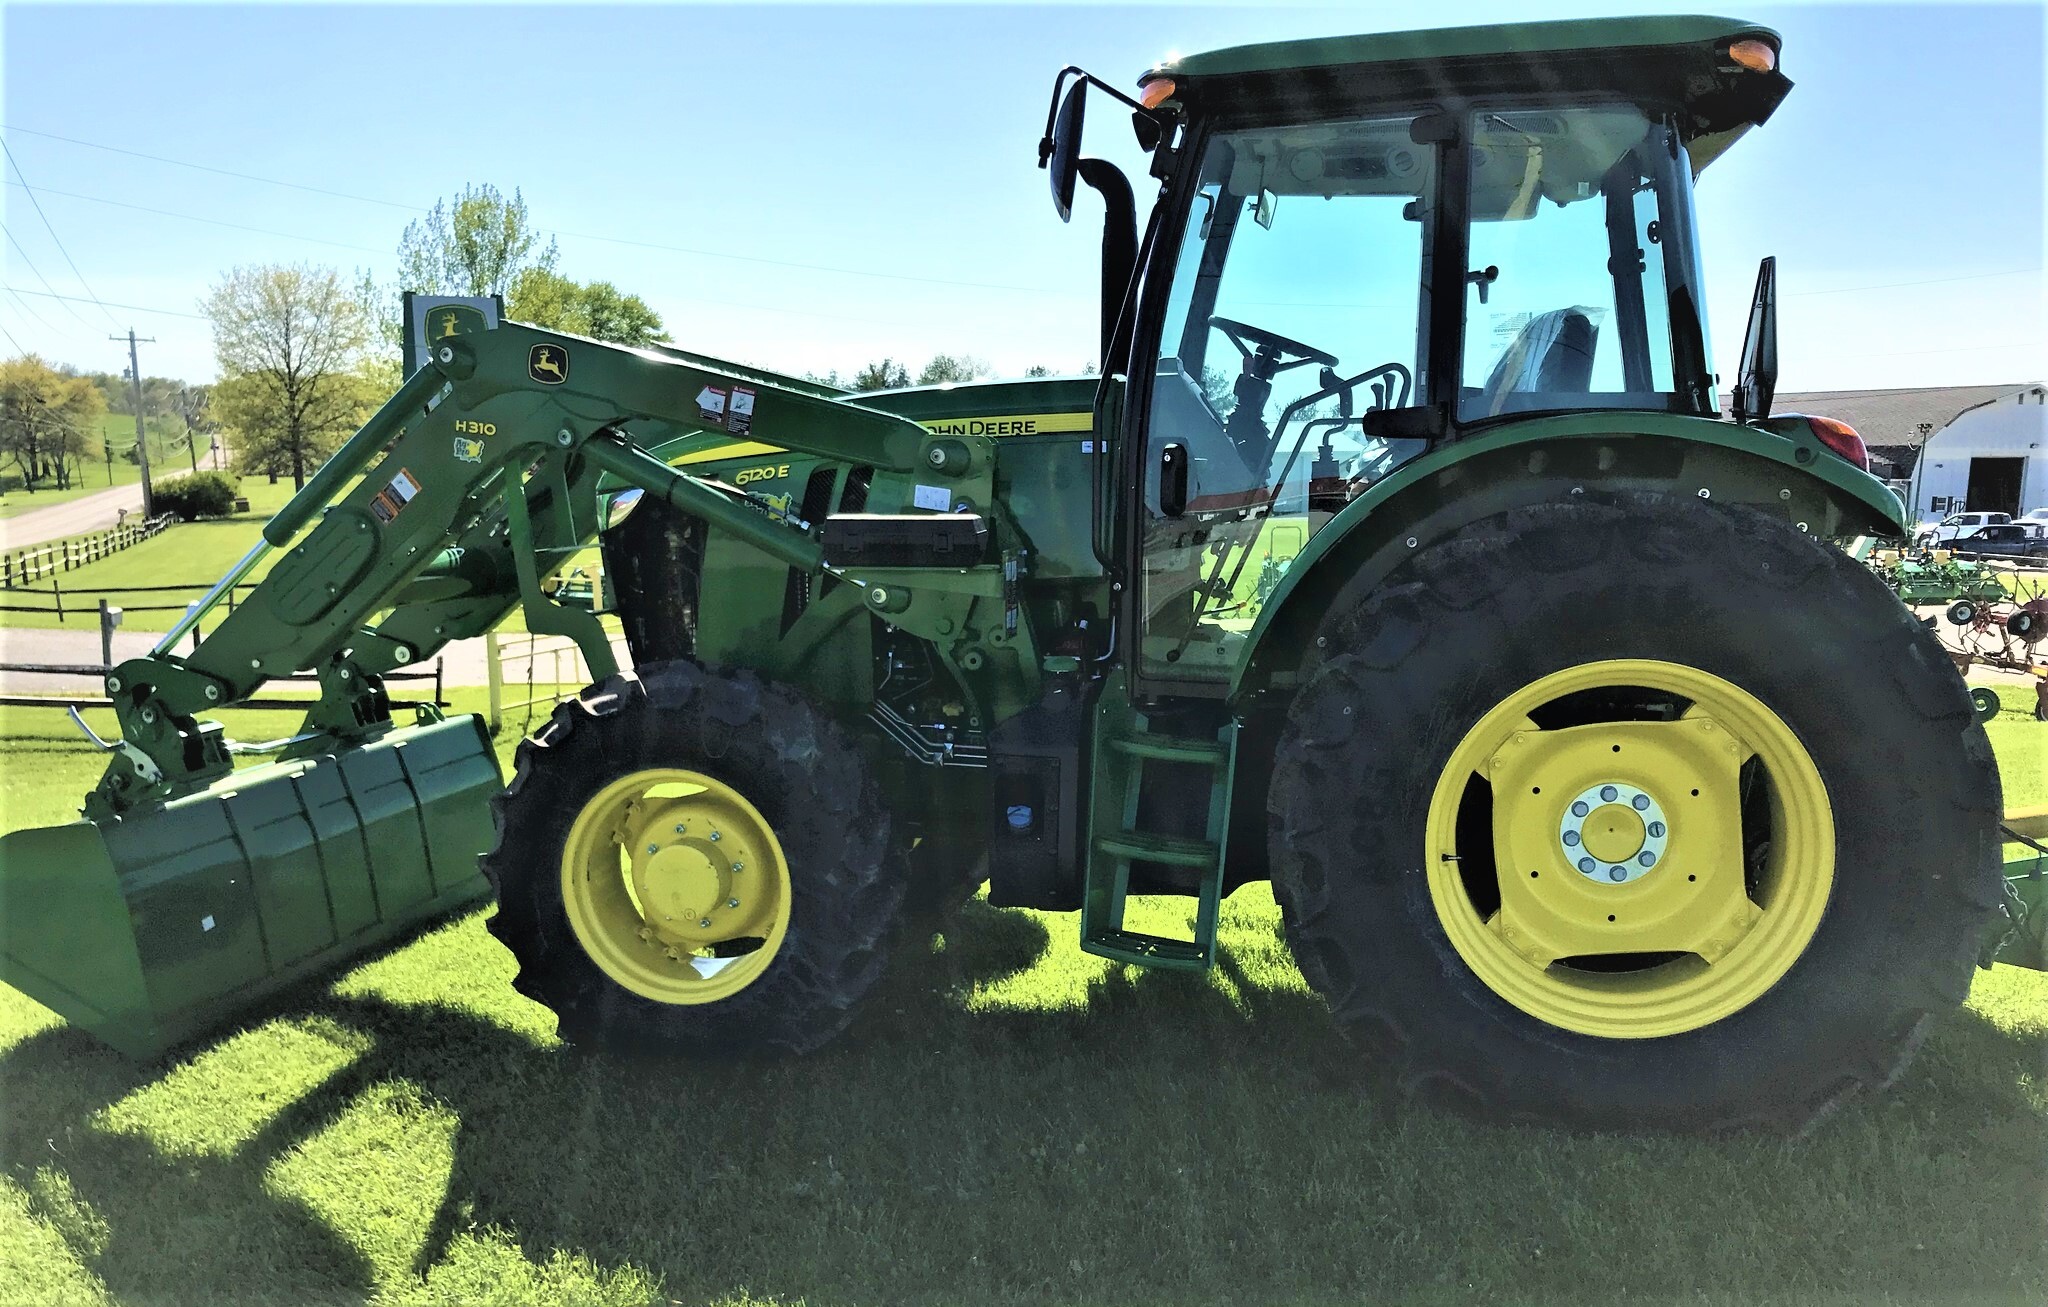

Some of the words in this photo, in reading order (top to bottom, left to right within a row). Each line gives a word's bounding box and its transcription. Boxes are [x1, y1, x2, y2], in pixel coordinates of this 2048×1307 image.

[926, 424, 966, 435] OHN
[969, 420, 1037, 436] DEERE
[735, 467, 776, 486] 6120
[777, 464, 790, 478] E
